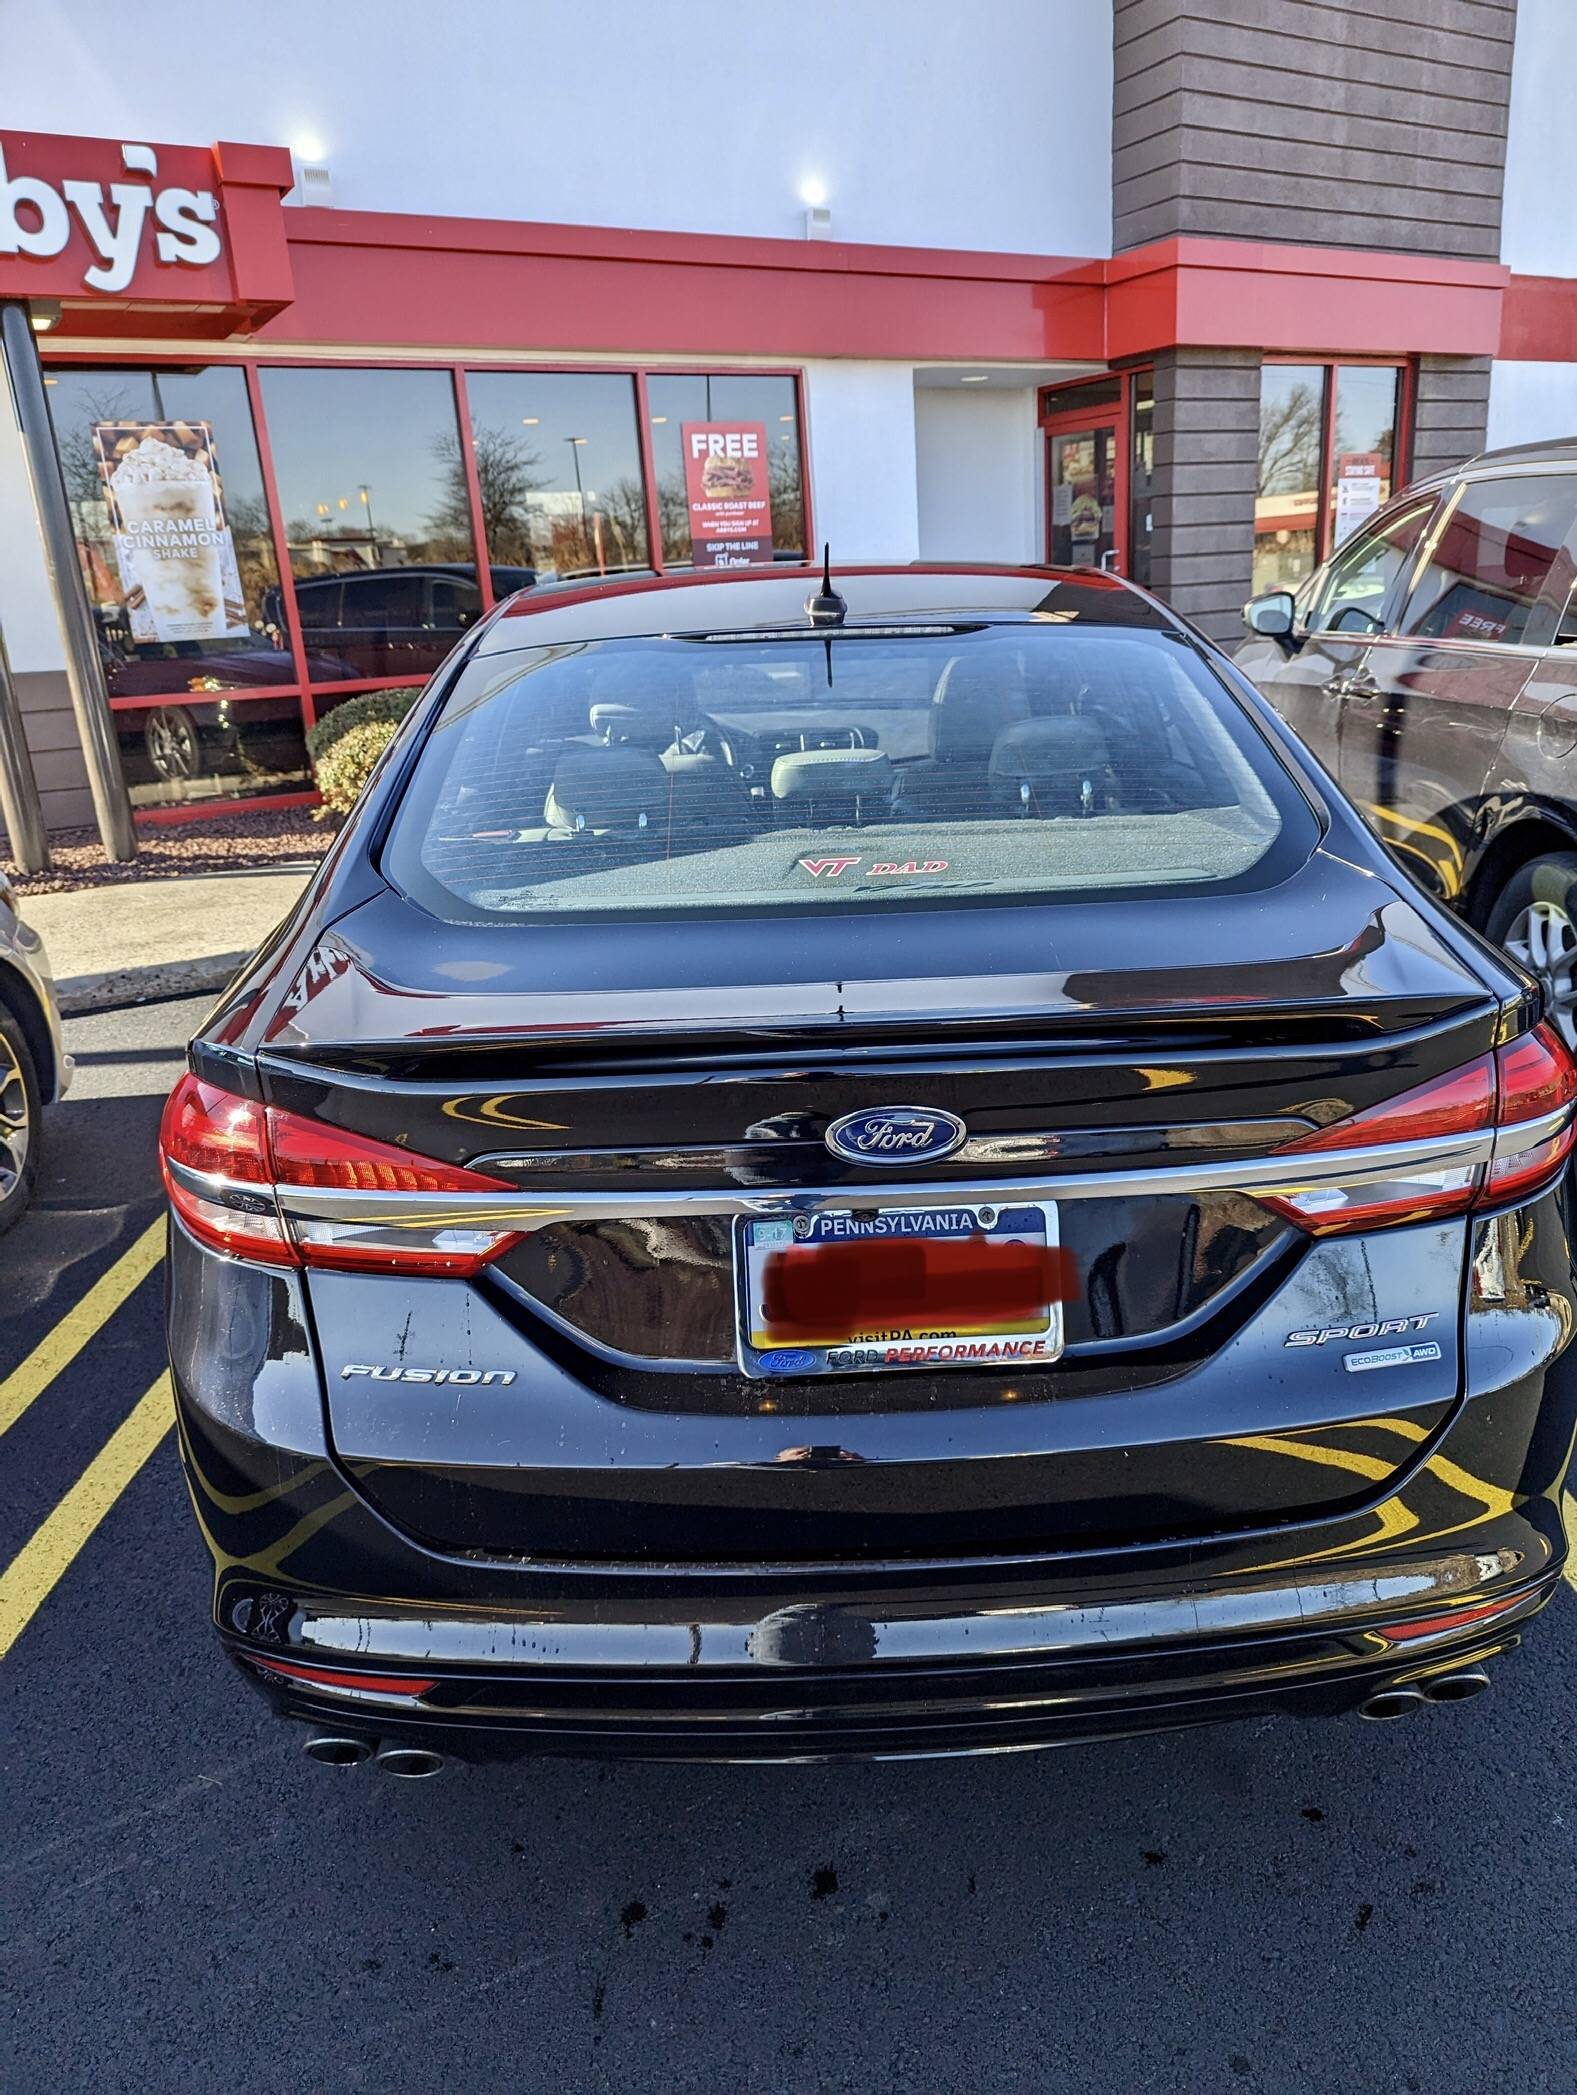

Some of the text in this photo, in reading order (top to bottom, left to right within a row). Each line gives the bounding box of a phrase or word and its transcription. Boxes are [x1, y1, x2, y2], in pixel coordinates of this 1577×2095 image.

[691, 433, 759, 459] FREE
[692, 501, 766, 512] CLASSIC ROAST BEEF
[127, 518, 216, 534] CARAMEL
[123, 533, 225, 549] CINNAMON
[706, 541, 759, 552] SKIP THE LINE
[153, 548, 199, 560] SHAKE
[799, 857, 948, 877] VT DAD
[857, 1118, 935, 1150] Ford
[820, 1212, 973, 1236] PENNSYLVANIA
[1284, 1312, 1439, 1348] SPORT
[827, 1340, 1046, 1365] FORD PERFORMANCE
[1412, 1347, 1436, 1359] AWD
[340, 1364, 518, 1386] FUSION
